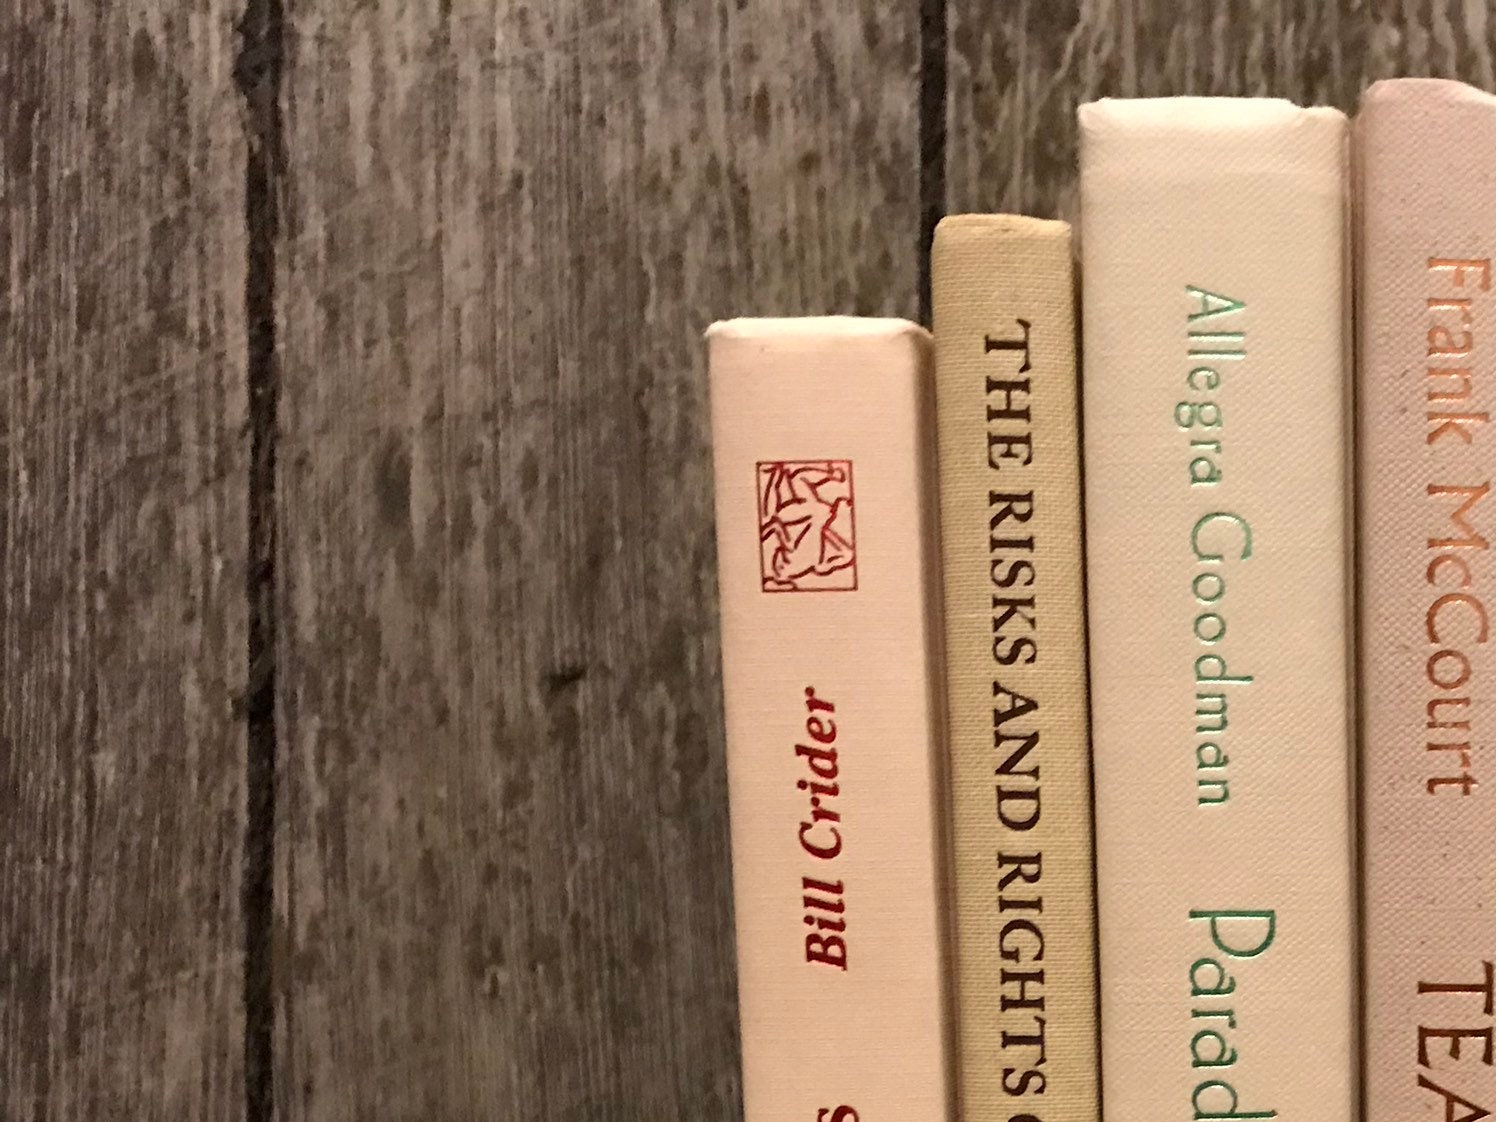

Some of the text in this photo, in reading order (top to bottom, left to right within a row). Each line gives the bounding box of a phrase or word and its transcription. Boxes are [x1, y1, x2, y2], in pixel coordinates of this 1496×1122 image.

[984, 319, 1033, 470] THE
[989, 490, 1039, 667] RISKS
[1174, 284, 1255, 806] Allegra Goodman
[1426, 257, 1491, 796] Frank McCourt
[795, 686, 847, 972] Bill Crider
[993, 682, 1043, 834] AND
[996, 852, 1048, 1094] RIGHTS
